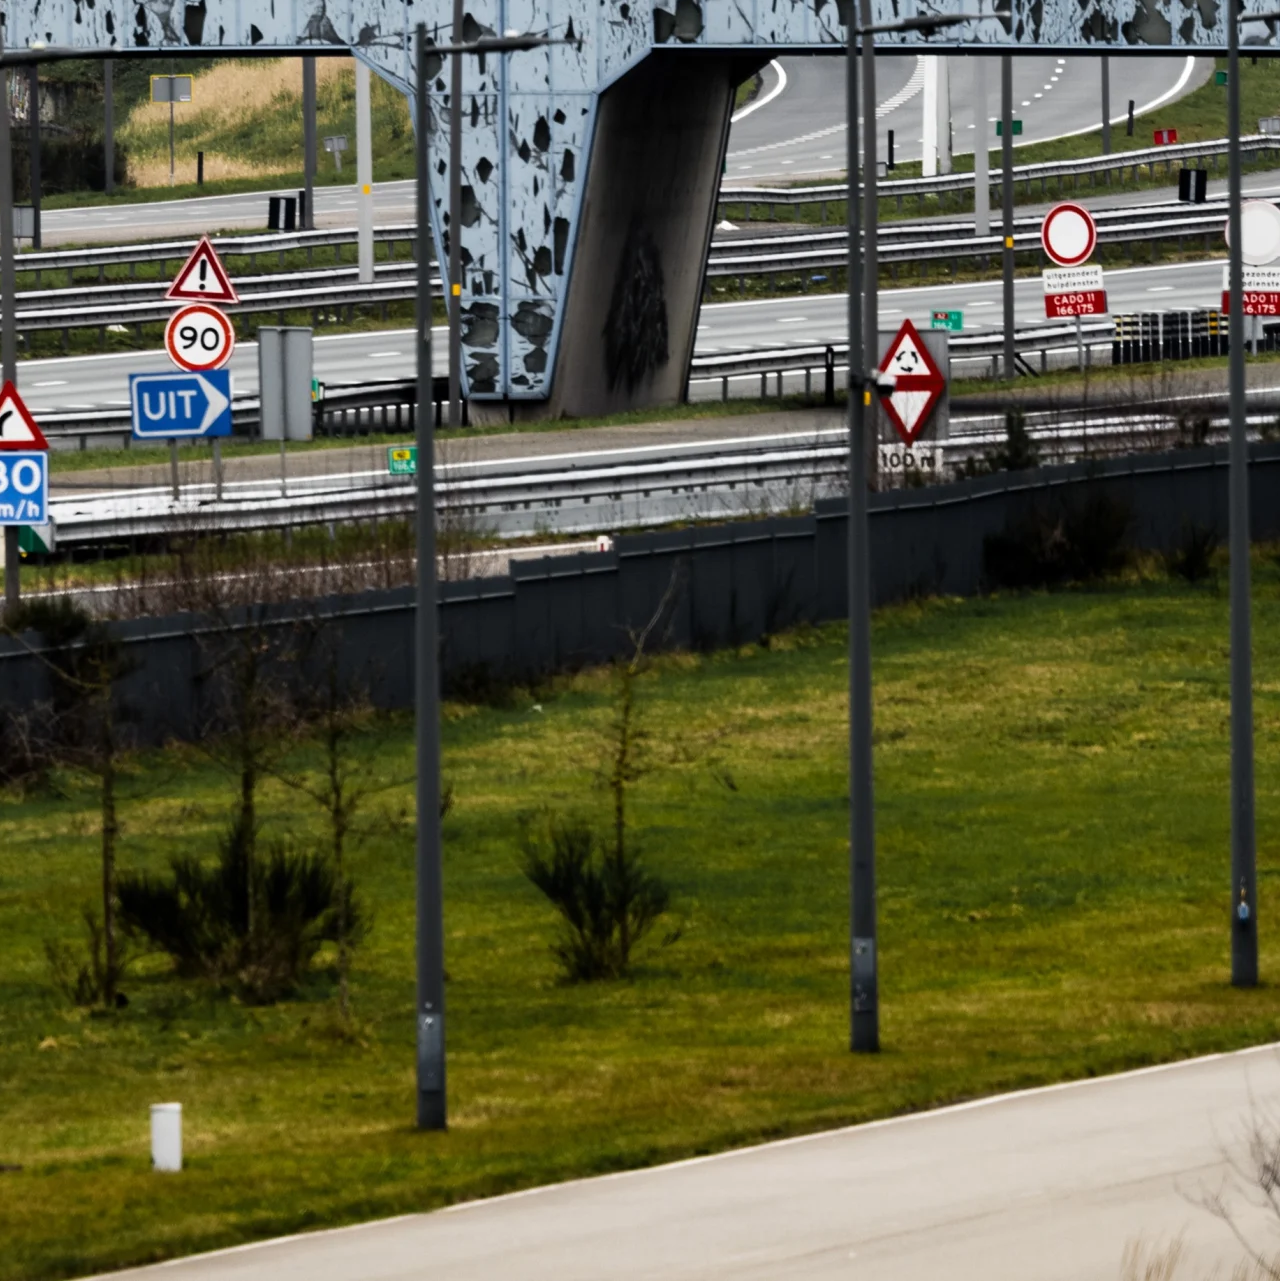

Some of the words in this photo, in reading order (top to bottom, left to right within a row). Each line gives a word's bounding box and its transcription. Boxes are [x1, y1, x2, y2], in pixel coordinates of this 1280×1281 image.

[1046, 270, 1098, 280] uitgezonderd
[1047, 280, 1099, 288] hulpdiensten
[1053, 294, 1084, 305] CADO
[1087, 293, 1095, 302] 11
[1243, 294, 1266, 303] ADO
[1270, 294, 1278, 303] 11
[1056, 304, 1094, 315] 166.175
[1243, 304, 1276, 314] 6.175
[180, 326, 220, 351] 90
[143, 390, 197, 421] UIT
[882, 452, 915, 468] 100
